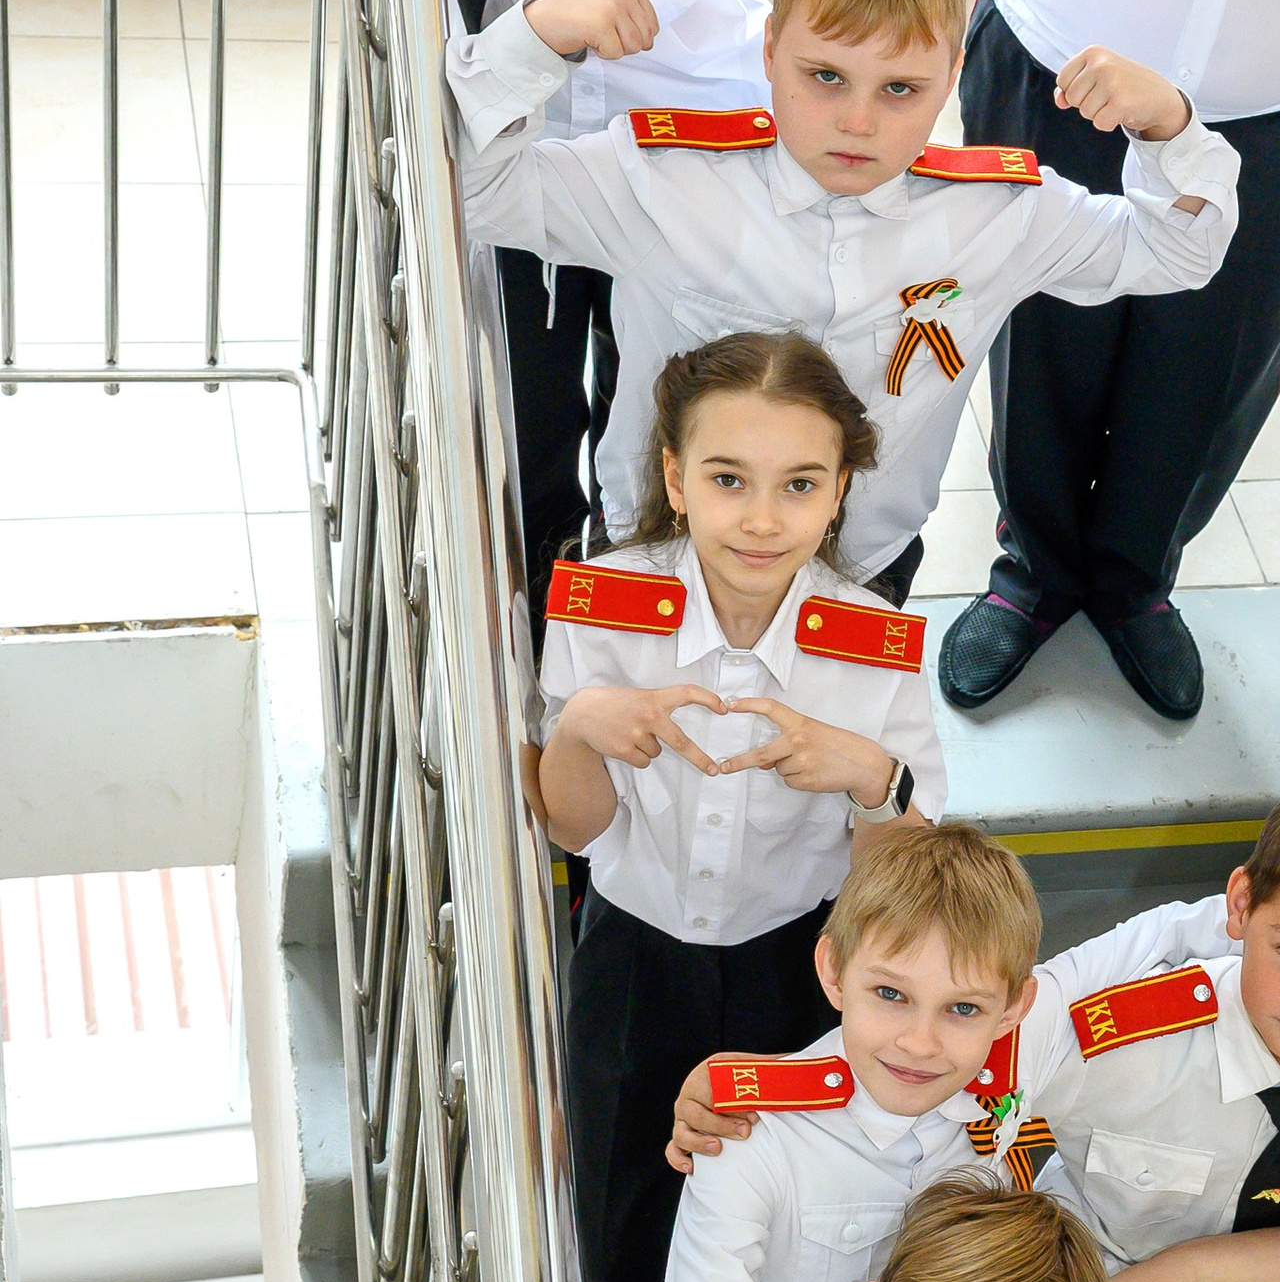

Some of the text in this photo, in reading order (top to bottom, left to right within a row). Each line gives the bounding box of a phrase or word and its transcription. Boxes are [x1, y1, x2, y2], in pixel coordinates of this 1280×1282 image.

[647, 113, 677, 137] КК
[999, 151, 1027, 173] КК
[566, 575, 595, 614] КК
[883, 620, 908, 658] КК
[1085, 999, 1117, 1042] КК
[732, 1067, 759, 1099] КК
